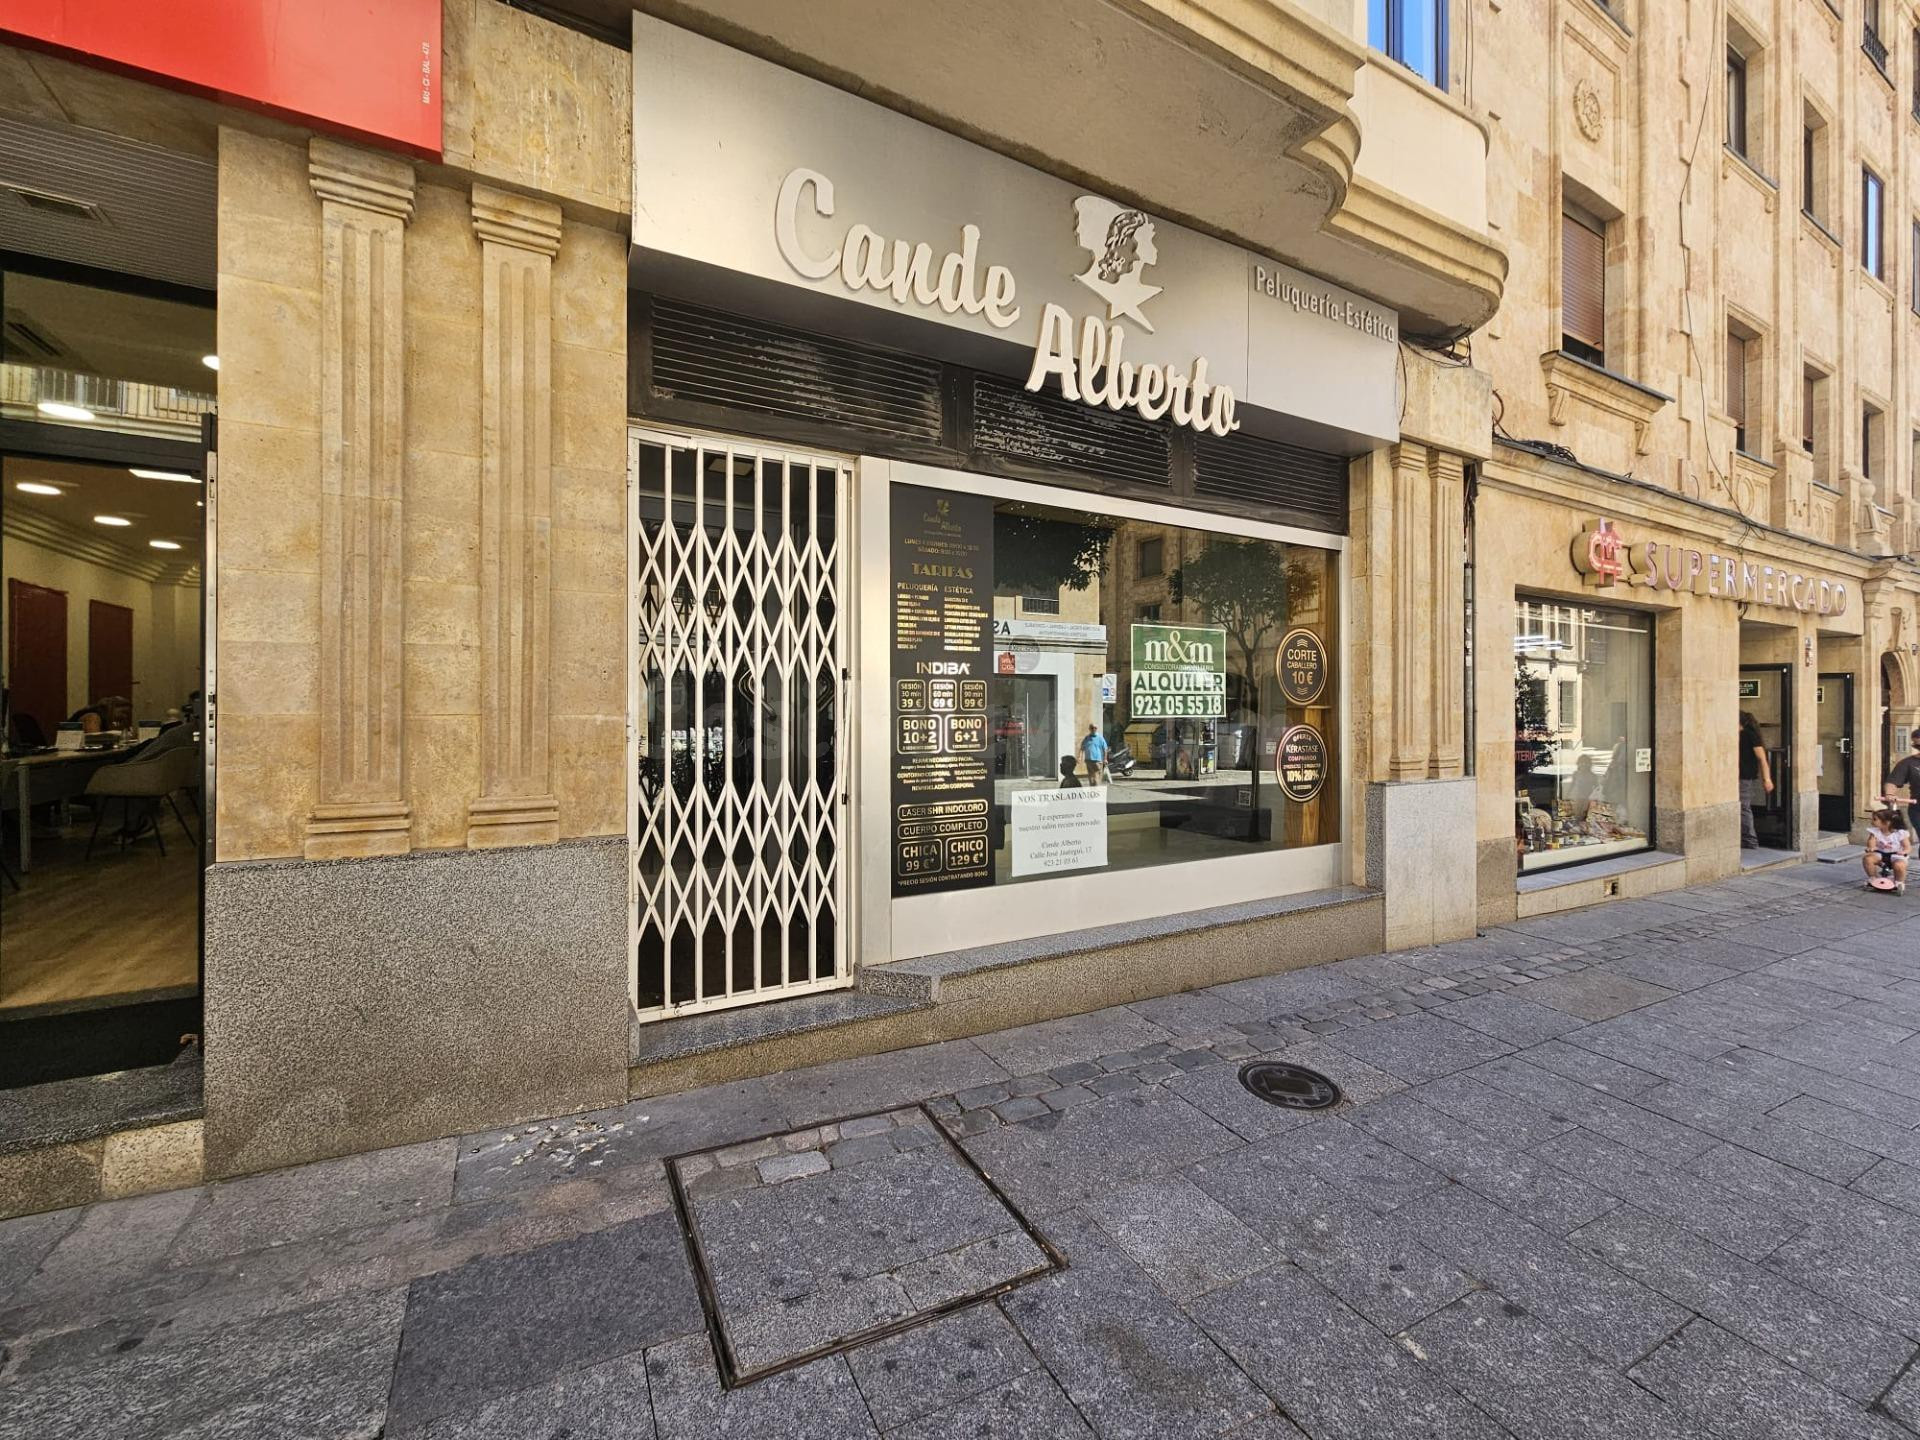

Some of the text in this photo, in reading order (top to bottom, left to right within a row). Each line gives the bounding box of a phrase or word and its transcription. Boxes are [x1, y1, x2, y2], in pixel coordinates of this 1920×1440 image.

[774, 167, 1020, 328] Cande
[1024, 303, 1240, 438] Alberto
[911, 562, 974, 580] TARIFAS
[1644, 541, 1847, 617] SUPERMERCADO
[897, 582, 939, 592] PELUQUERÍA
[1144, 630, 1215, 664] m&m
[1287, 648, 1317, 661] CORTE
[916, 661, 971, 675] INDIBA
[1286, 661, 1317, 670] CABALLERO
[1134, 672, 1223, 692] ALQUILER
[1292, 671, 1305, 685] 10
[901, 682, 922, 690] SESIÓN
[901, 698, 914, 708] 39
[932, 698, 945, 708] 69
[964, 698, 976, 708] 99
[1135, 695, 1222, 715] 923 05 55 18
[903, 719, 937, 730] BONO
[950, 718, 982, 730] BONO
[903, 731, 937, 744] 10+2
[954, 730, 979, 743] 6+1
[1285, 743, 1319, 754] KÉRASTASE
[1018, 790, 1100, 803] NOS TRASLADAMOS
[901, 803, 984, 817] LASER SHR INDOLORO
[903, 821, 983, 836] CUERPO COMPLETO
[902, 844, 938, 858] CHICA
[950, 839, 984, 853] CHICO
[906, 860, 920, 871] 99
[950, 854, 970, 866] 129
